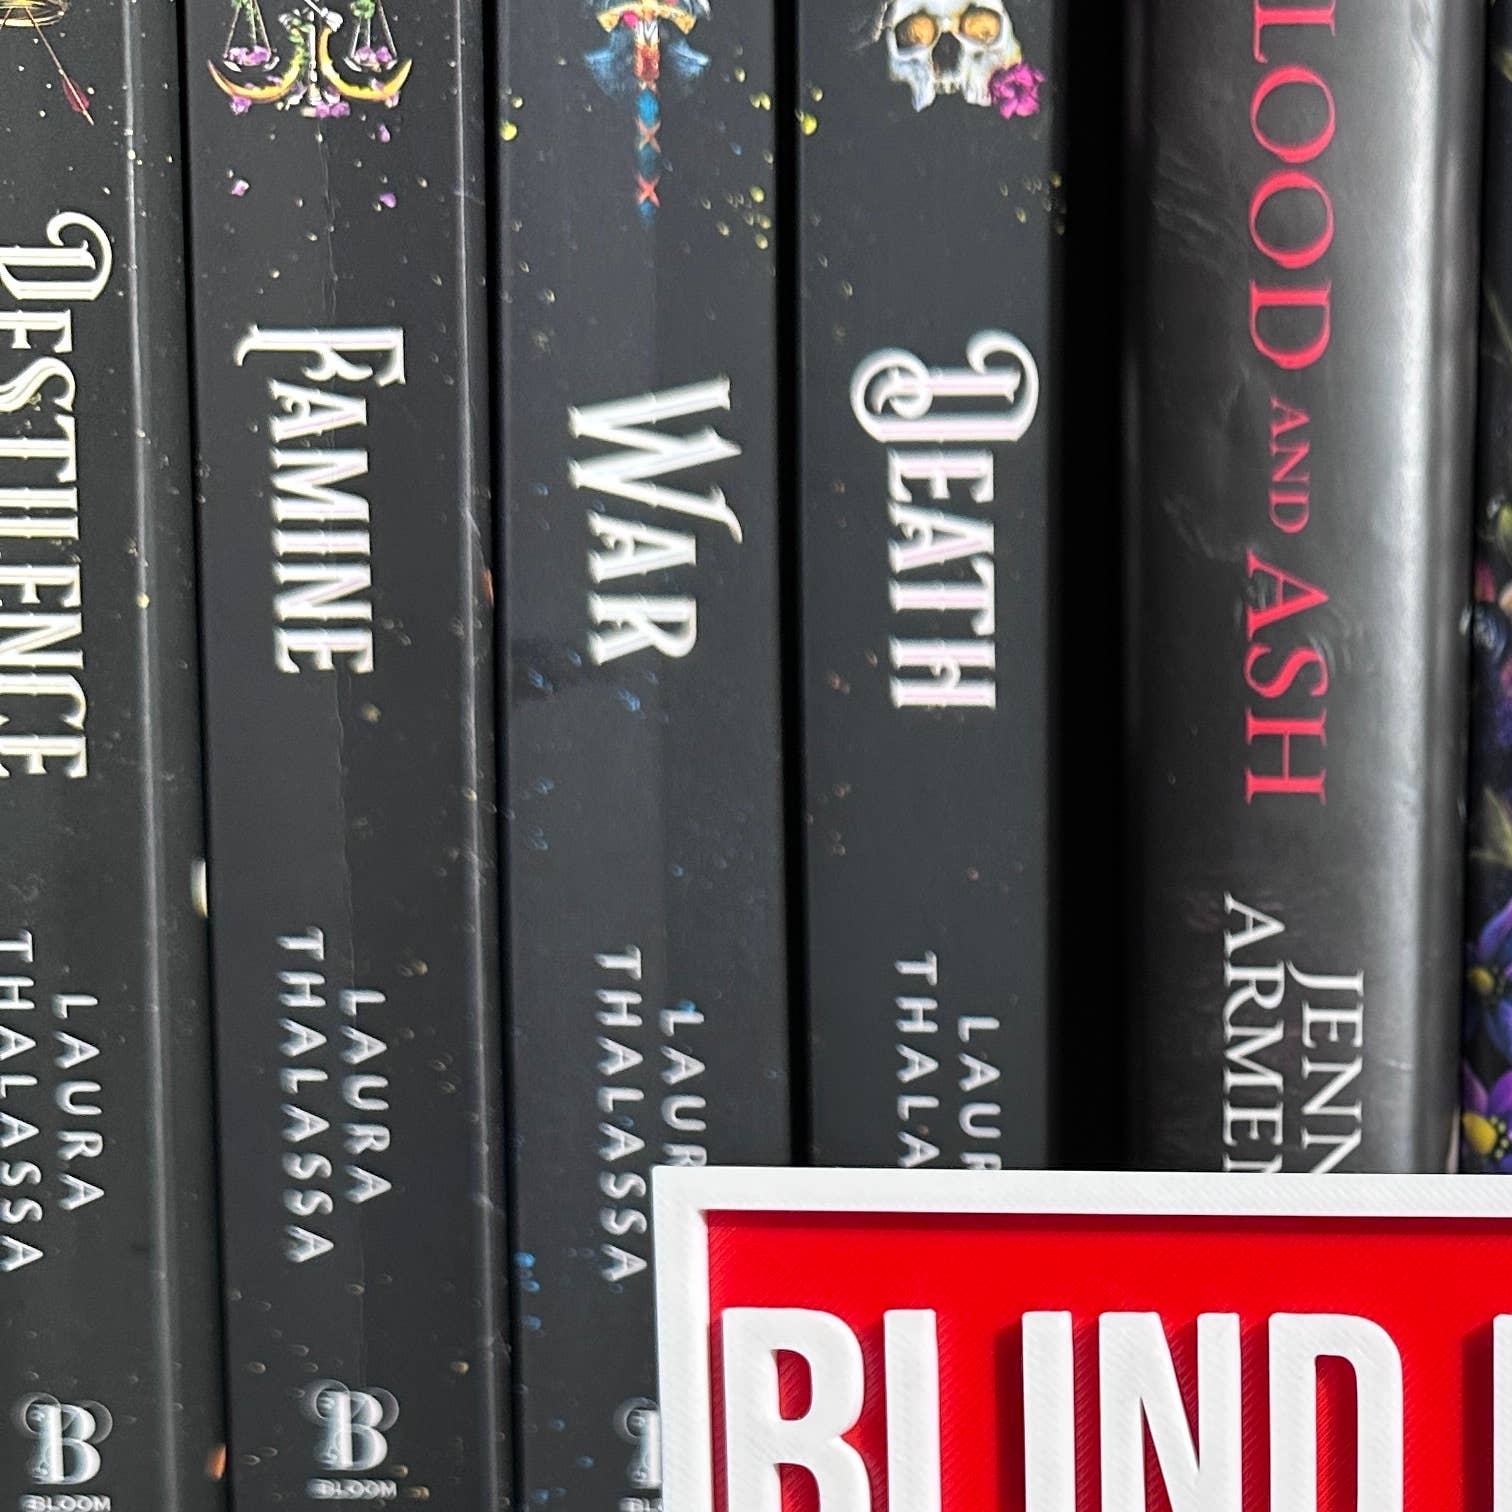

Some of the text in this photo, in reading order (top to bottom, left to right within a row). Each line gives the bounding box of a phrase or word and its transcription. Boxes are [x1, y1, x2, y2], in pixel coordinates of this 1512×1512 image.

[0, 211, 112, 779] PESTILENCE
[233, 323, 406, 674] FAMINE
[569, 375, 743, 666] WAR
[850, 330, 1039, 709] DEATH
[1269, 396, 1310, 534] AND
[1244, 547, 1329, 804] ASH
[0, 928, 43, 1272] THALASSA
[53, 994, 104, 1211] LAURA
[277, 926, 334, 1264] THALASSA
[339, 989, 393, 1203] LAURA
[594, 945, 648, 1282] THALASSA
[894, 951, 940, 1168] THALA
[306, 1478, 398, 1499] BLOOM
